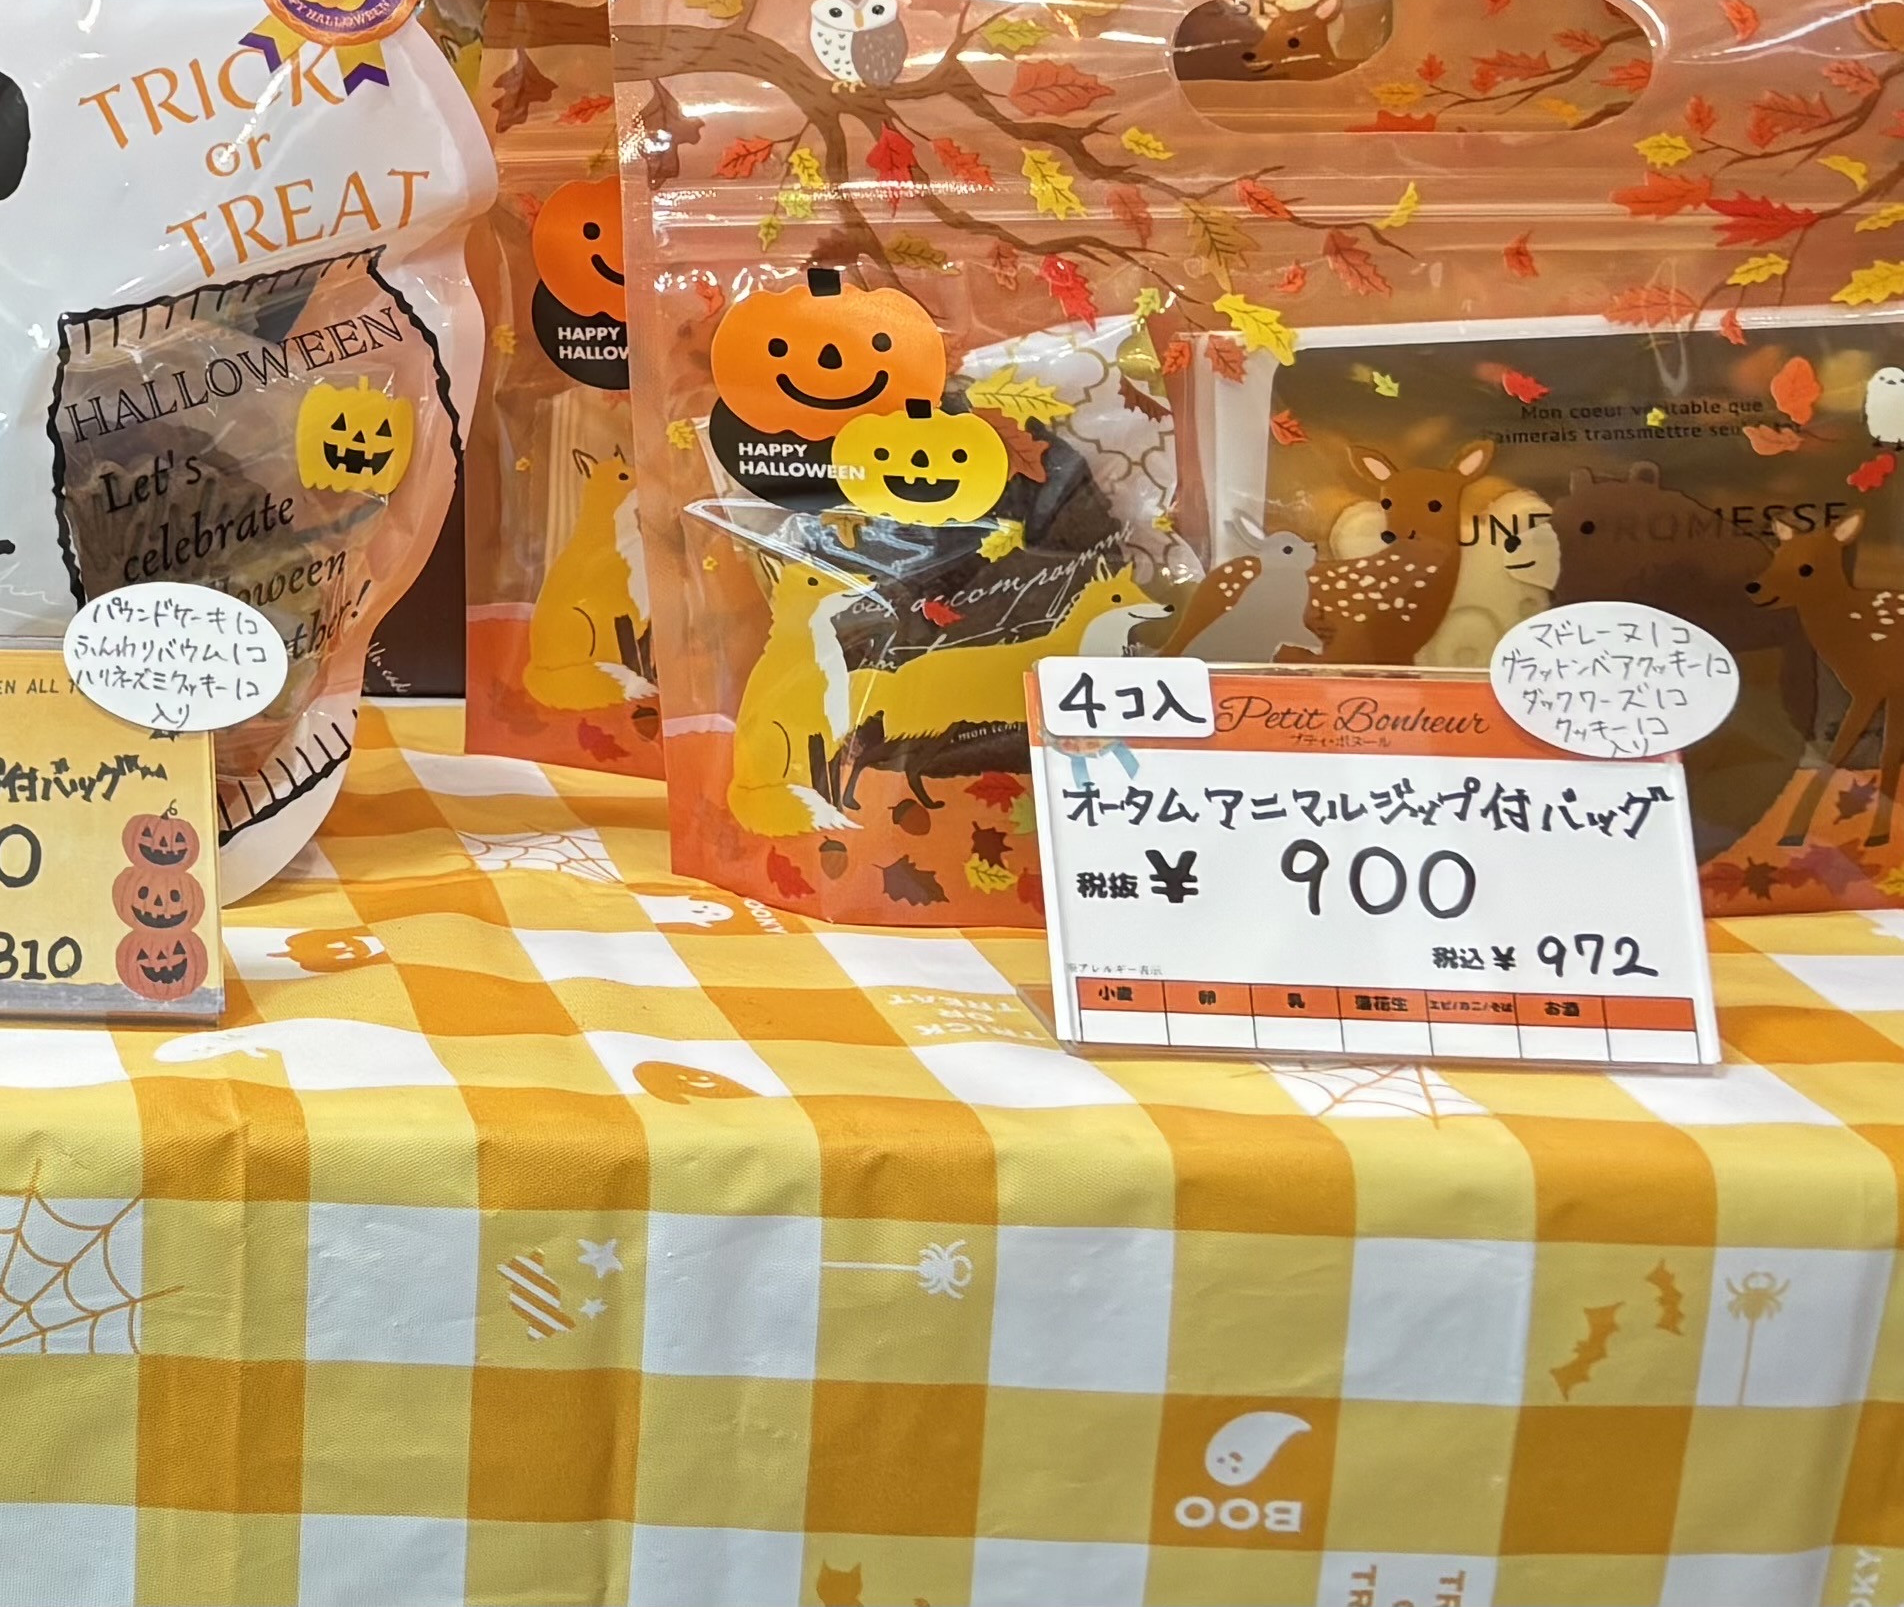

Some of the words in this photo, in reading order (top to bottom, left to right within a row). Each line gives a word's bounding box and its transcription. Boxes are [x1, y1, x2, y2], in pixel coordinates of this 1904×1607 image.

[203, 129, 273, 178] or
[165, 169, 432, 279] TREAT
[557, 326, 621, 343] HAPPY
[64, 305, 404, 445] HALLOWEEN
[1520, 405, 1563, 421] Mon
[1729, 400, 1763, 417] que
[737, 442, 808, 460] HAPPY
[738, 460, 867, 482] HALLOWEEN
[99, 452, 204, 515] Let's
[121, 491, 296, 585] celebrate
[25, 678, 60, 696] ALL
[1057, 671, 1208, 730] 4コ入
[1214, 694, 1328, 734] Petit
[1336, 695, 1491, 737] Bonheur
[1076, 872, 1140, 901] 税抜
[1280, 837, 1478, 920] 900
[1431, 945, 1485, 971] 税込
[1535, 934, 1659, 980] 972
[1173, 1494, 1304, 1534] BOO
